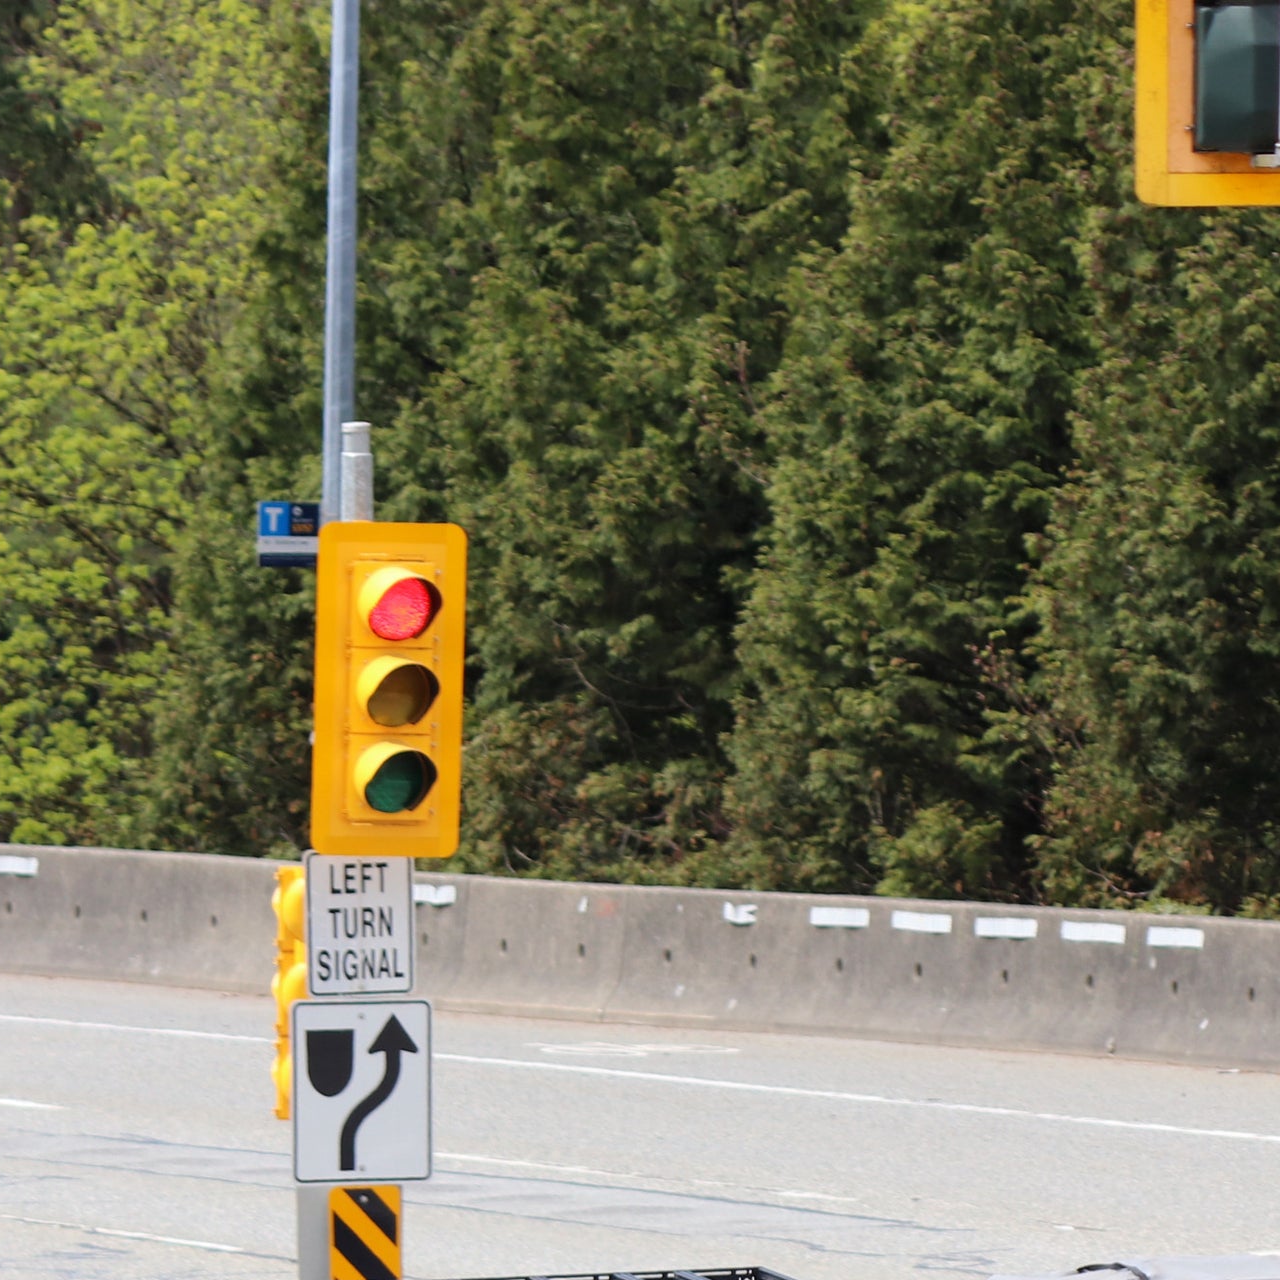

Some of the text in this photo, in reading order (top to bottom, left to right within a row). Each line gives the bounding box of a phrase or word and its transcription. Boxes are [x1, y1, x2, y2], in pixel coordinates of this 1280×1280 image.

[264, 507, 284, 532] T
[330, 862, 389, 894] LEFT
[329, 907, 394, 939] TURN
[317, 950, 405, 981] SIGNAL
